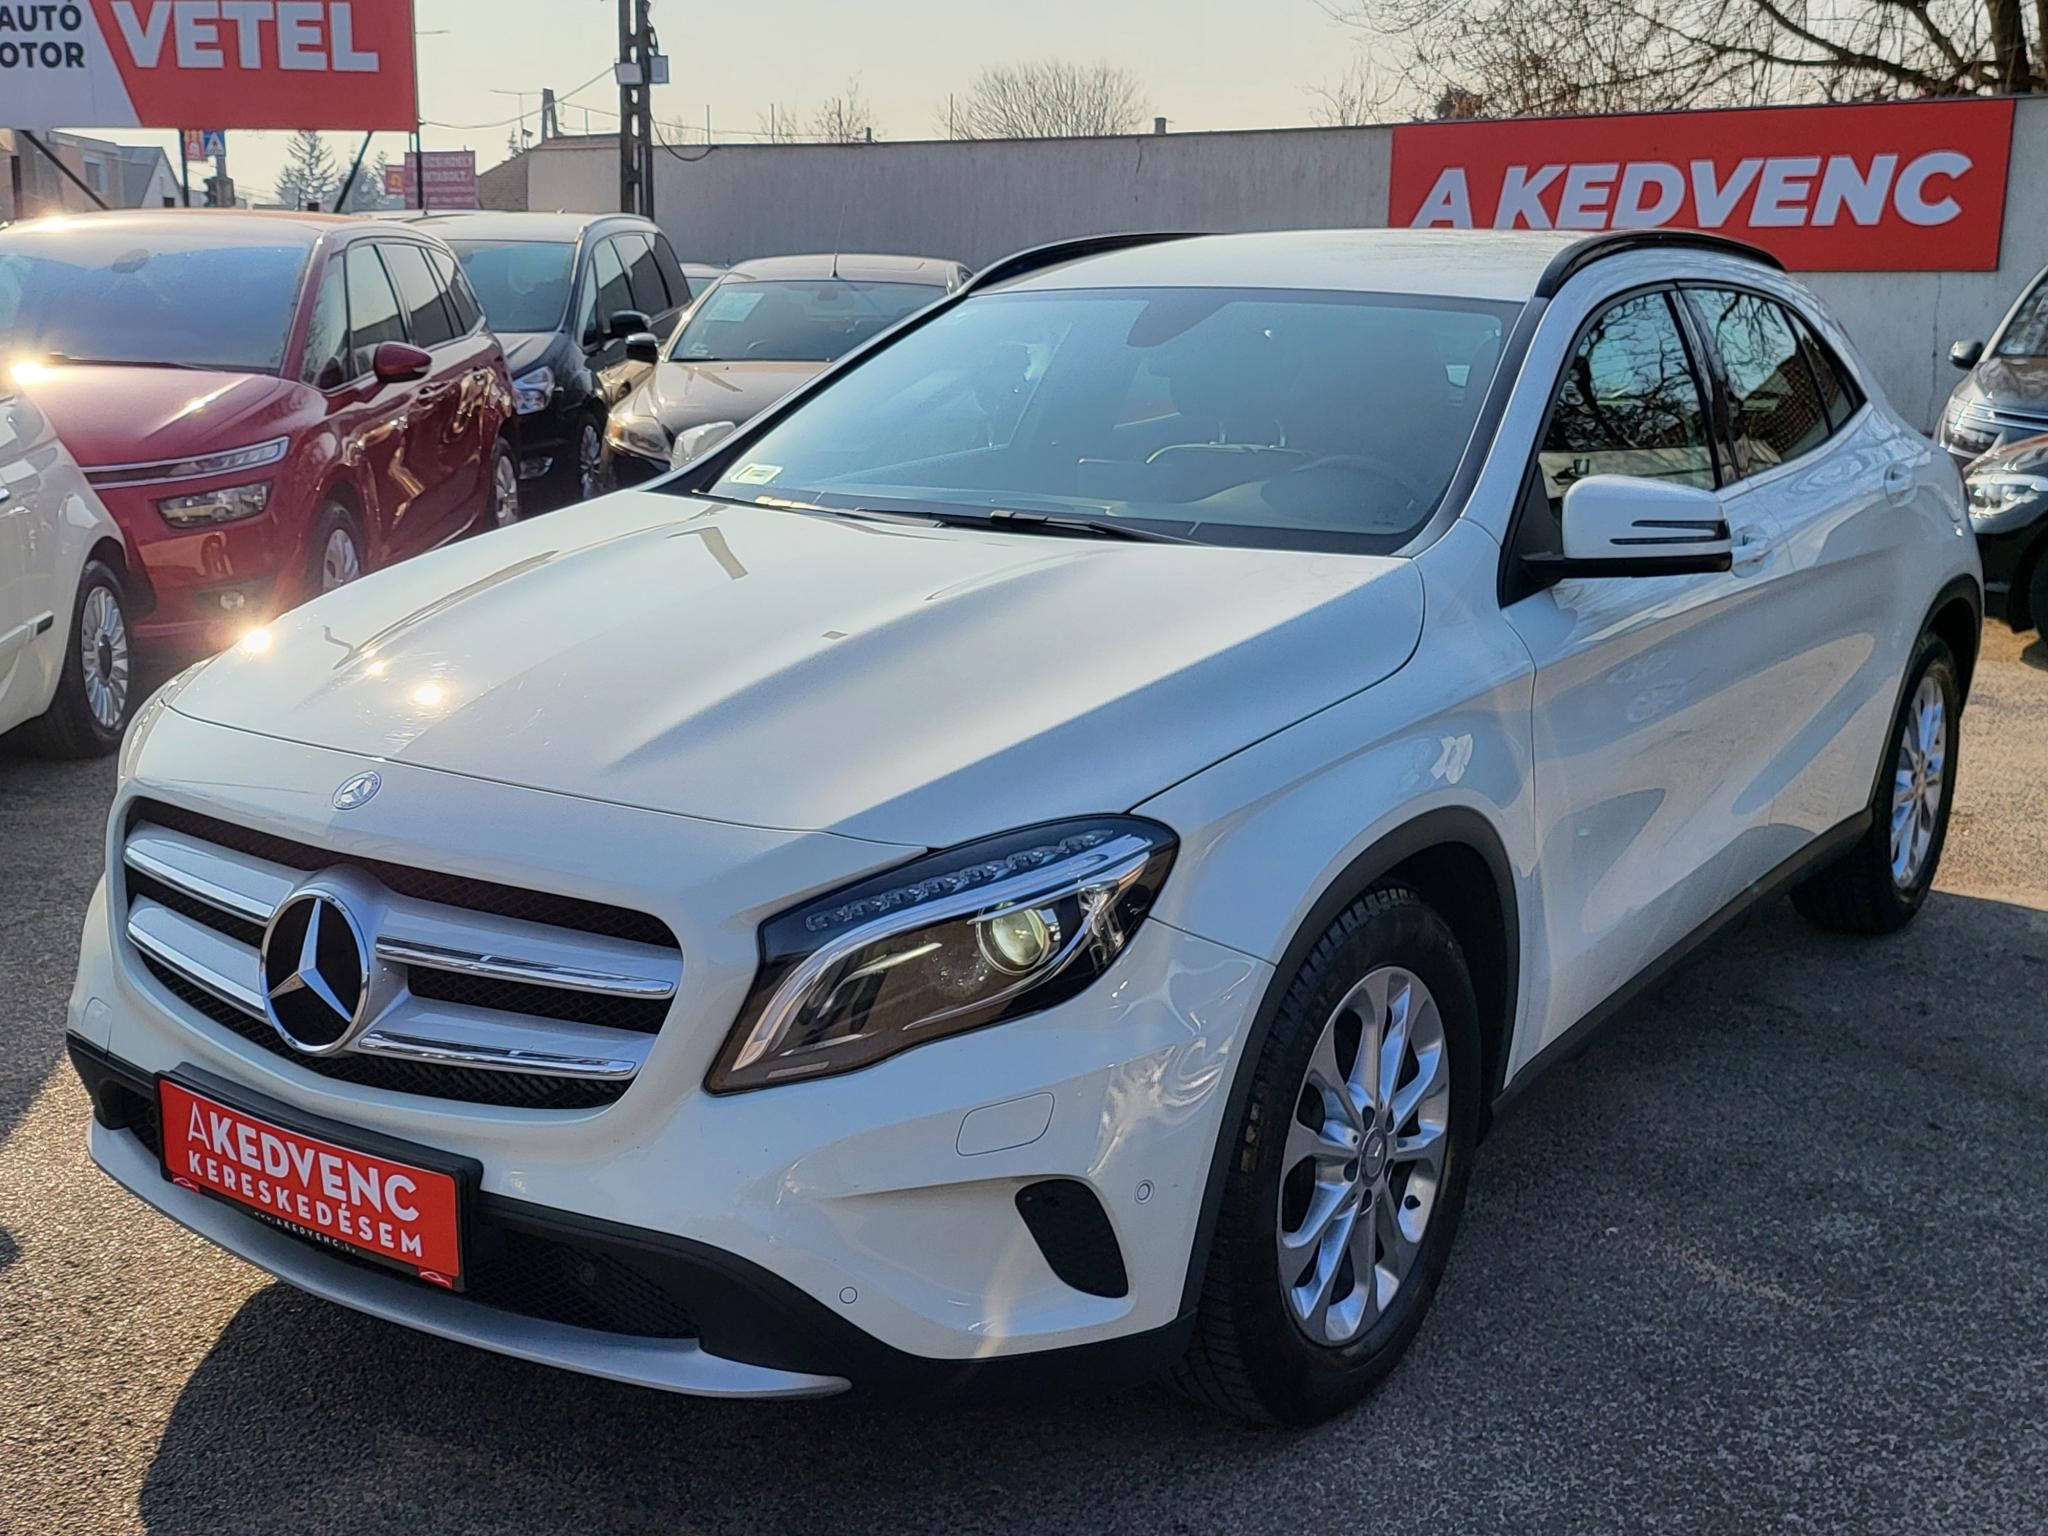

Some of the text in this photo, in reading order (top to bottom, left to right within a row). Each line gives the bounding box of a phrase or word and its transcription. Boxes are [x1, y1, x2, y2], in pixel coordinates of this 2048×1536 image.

[1409, 149, 1973, 229] A KEDVENC
[187, 1150, 423, 1258] KERESKEDÉSEM
